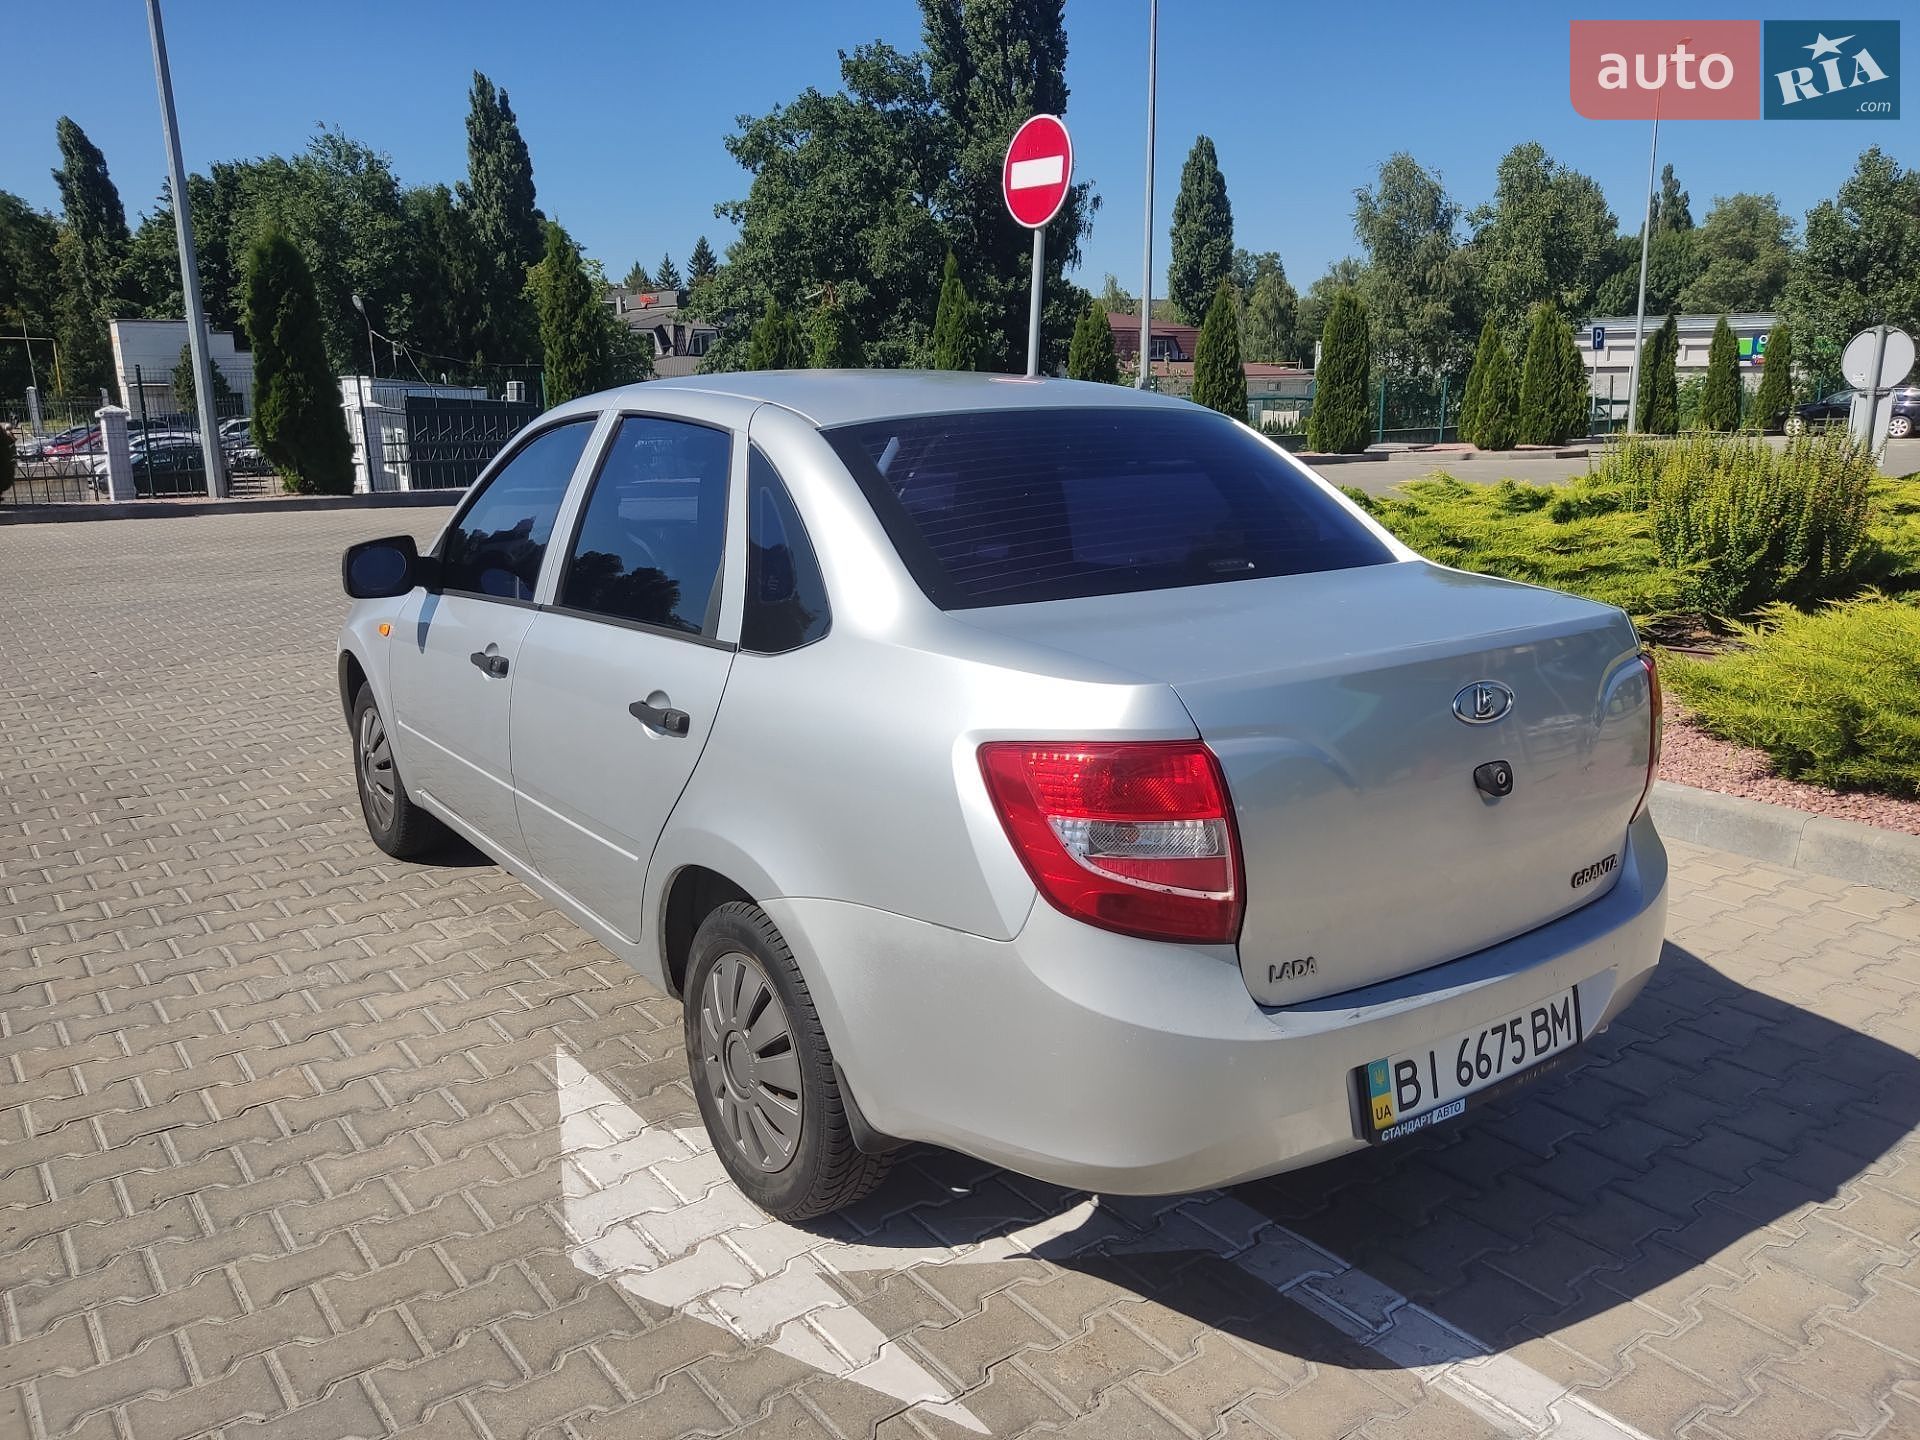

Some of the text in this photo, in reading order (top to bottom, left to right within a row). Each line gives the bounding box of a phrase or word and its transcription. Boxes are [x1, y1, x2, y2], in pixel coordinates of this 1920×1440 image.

[1571, 853, 1618, 888] GRANTA
[1269, 956, 1317, 983] LADA
[1394, 1050, 1439, 1112] BI
[1456, 1016, 1526, 1088] 6675
[1531, 997, 1572, 1056] BM
[1375, 1104, 1392, 1121] UA
[1381, 1102, 1462, 1142] СТАНДАРТ АВТО
